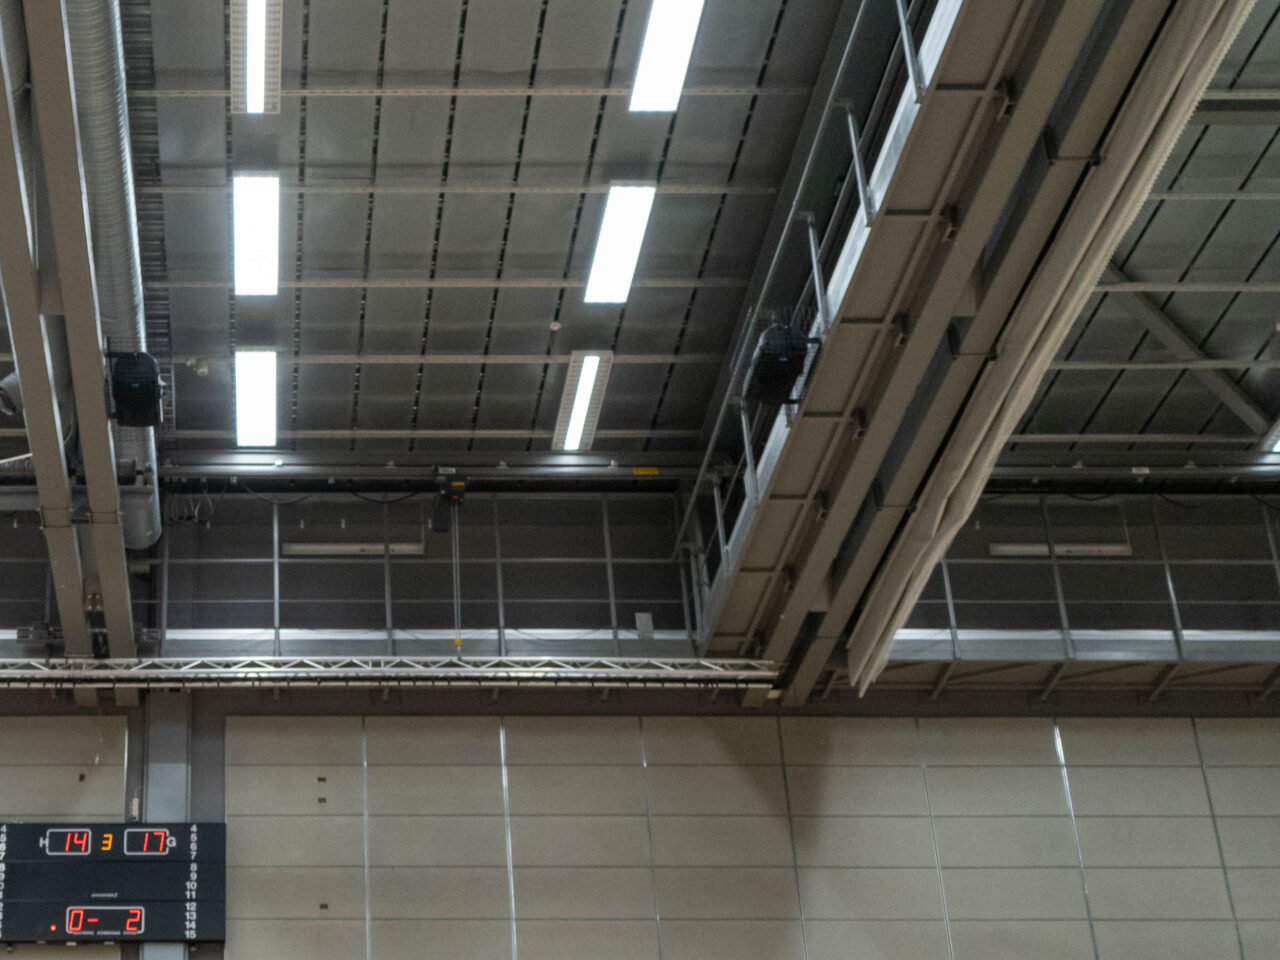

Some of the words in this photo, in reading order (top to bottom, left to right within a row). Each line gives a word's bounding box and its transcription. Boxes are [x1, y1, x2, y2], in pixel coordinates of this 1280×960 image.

[40, 837, 49, 847] H
[65, 832, 88, 852] 14
[101, 833, 113, 851] 3
[143, 831, 166, 852] 17
[166, 836, 176, 847] G
[68, 909, 84, 931] 0
[125, 909, 141, 931] 2
